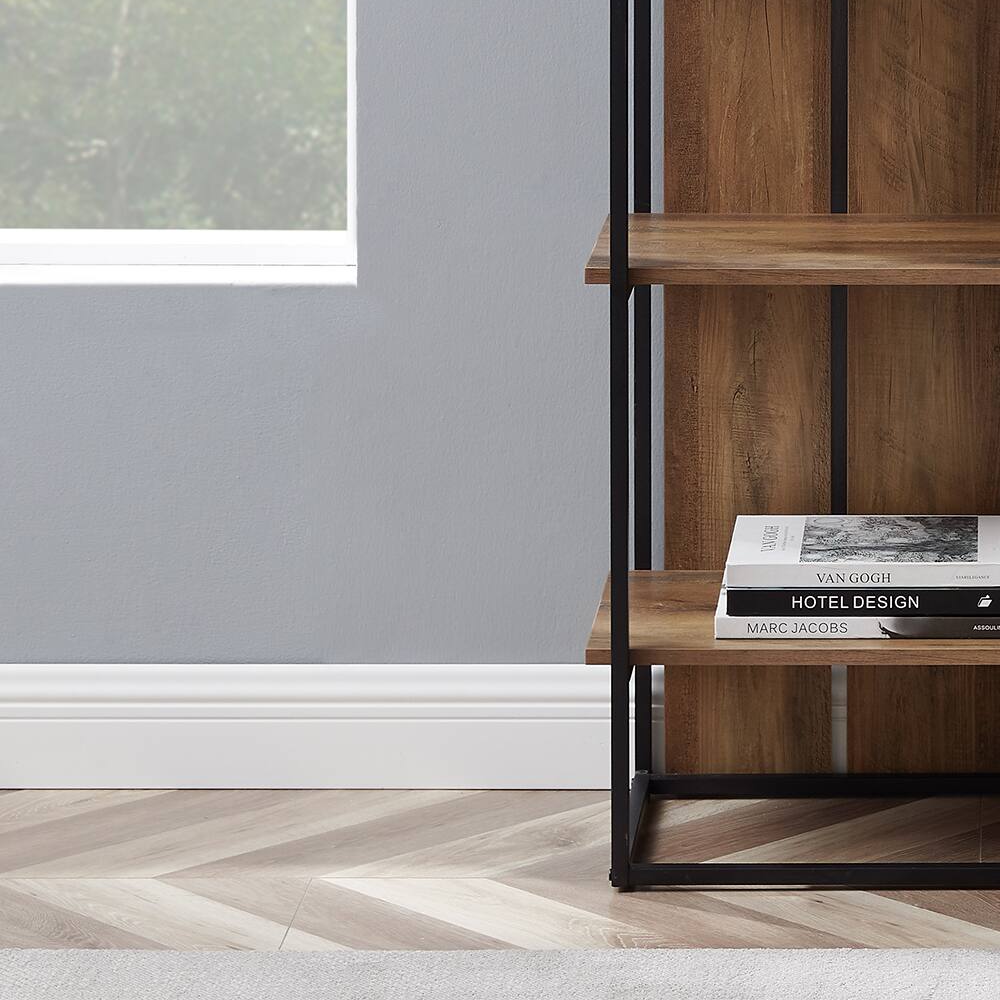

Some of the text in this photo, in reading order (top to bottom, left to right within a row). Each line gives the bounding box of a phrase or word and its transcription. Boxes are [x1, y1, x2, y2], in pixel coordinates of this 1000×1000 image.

[816, 573, 891, 584] VAN GOGH
[791, 595, 919, 609] HOTEL DESIGN
[747, 622, 848, 634] MARC JACOBS
